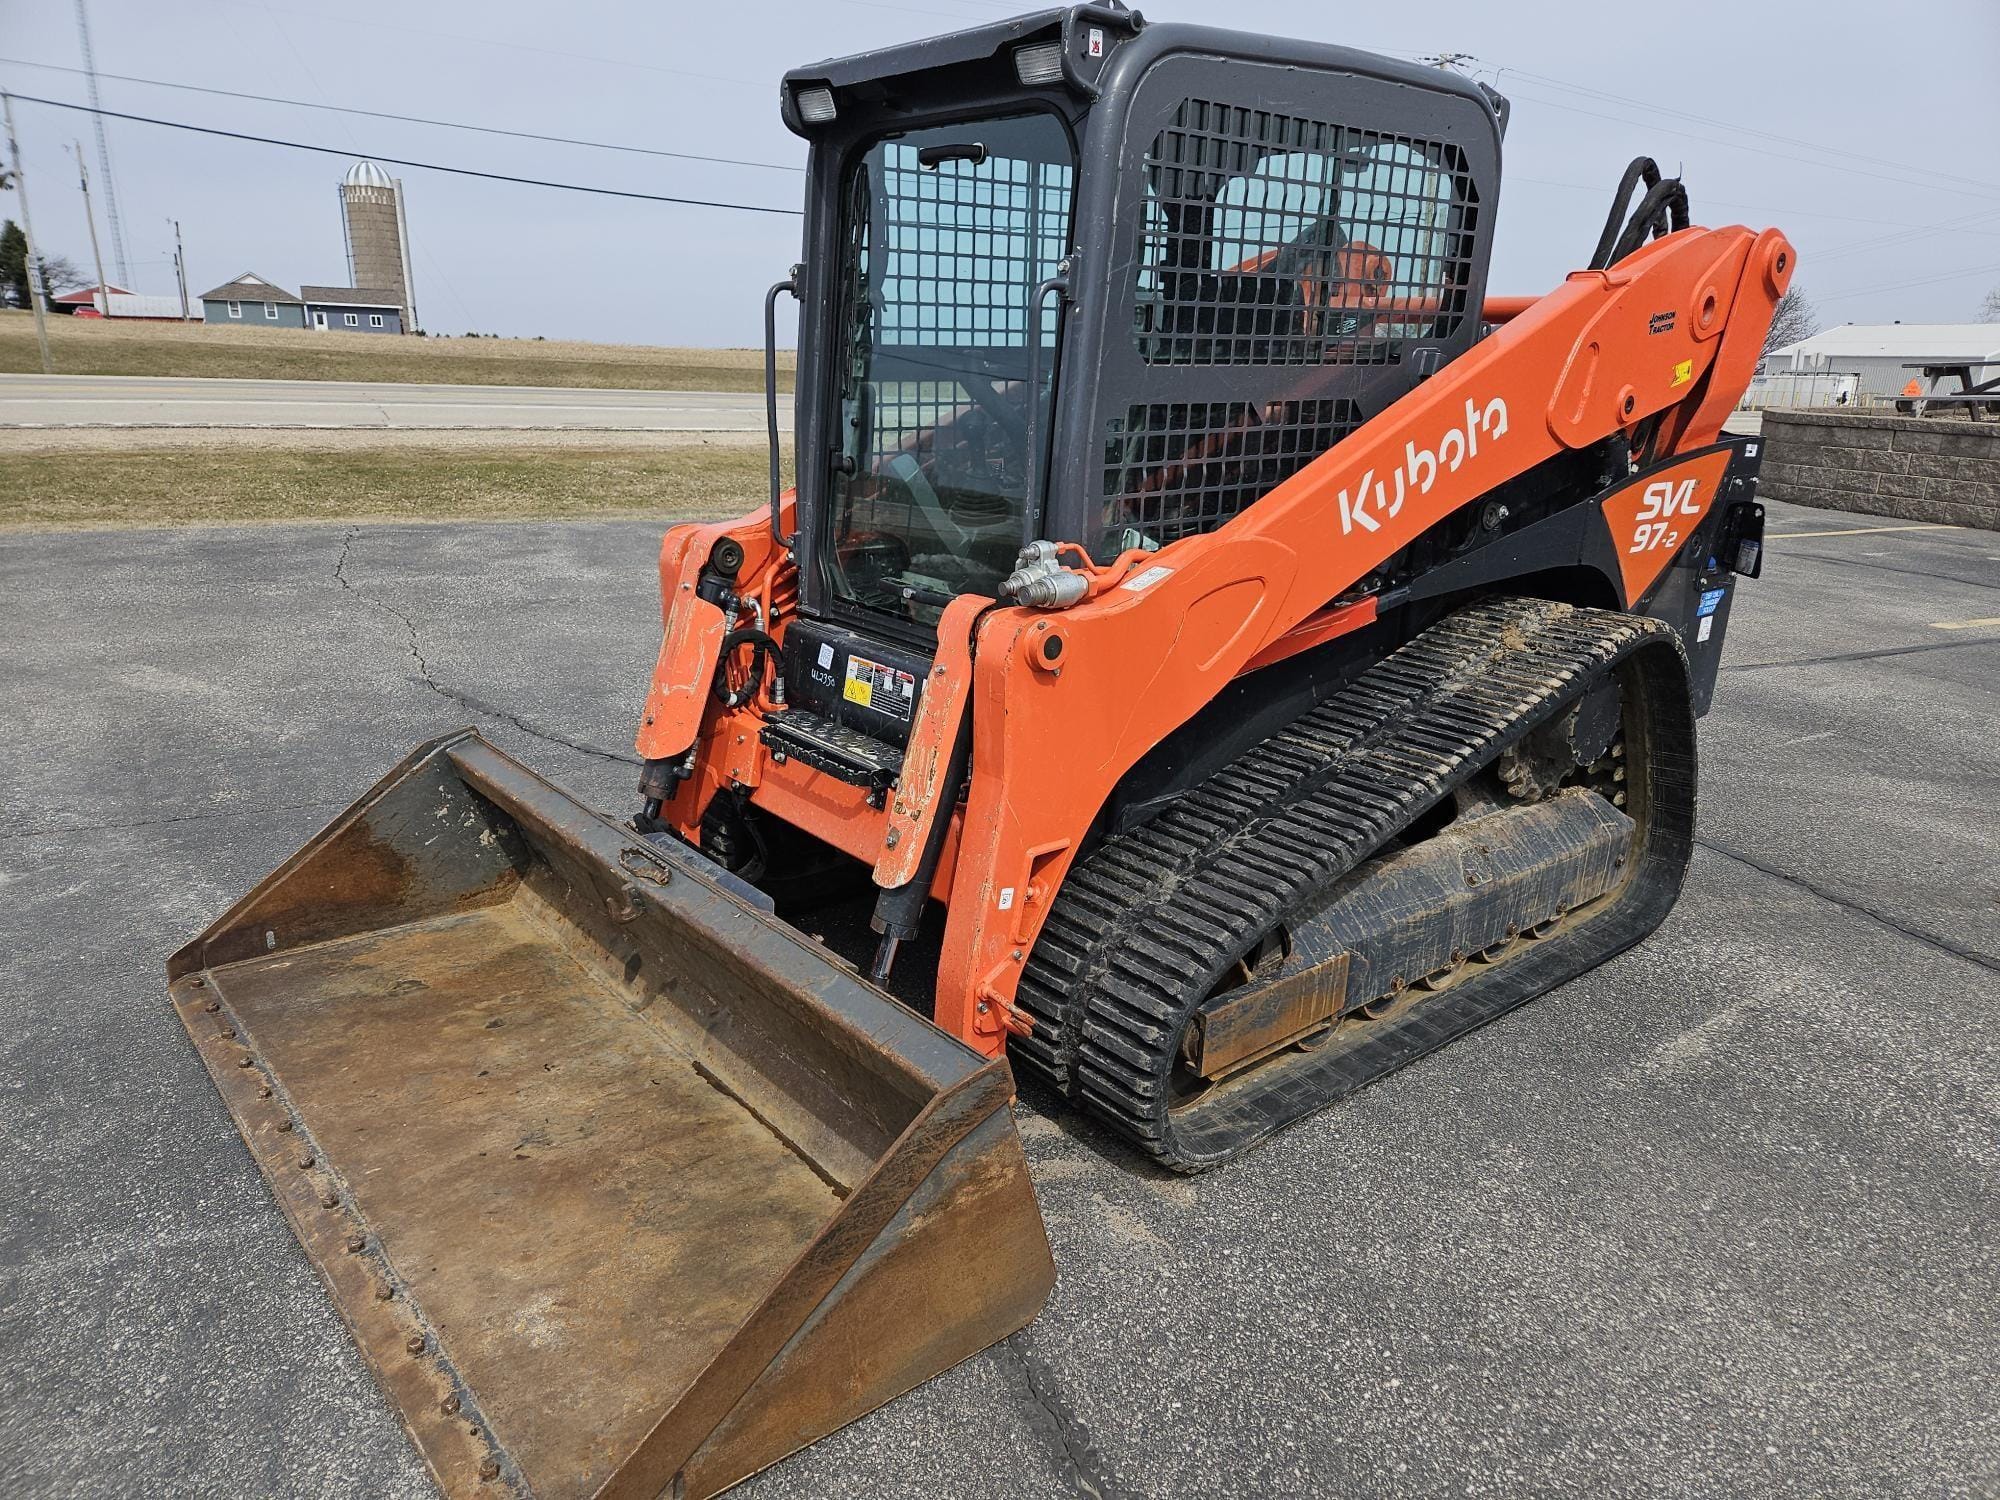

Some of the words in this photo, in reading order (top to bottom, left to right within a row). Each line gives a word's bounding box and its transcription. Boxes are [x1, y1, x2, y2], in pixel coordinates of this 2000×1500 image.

[1338, 397, 1508, 536] Kubota
[1635, 479, 1700, 520] SVL
[1629, 521, 1678, 554] 97-2
